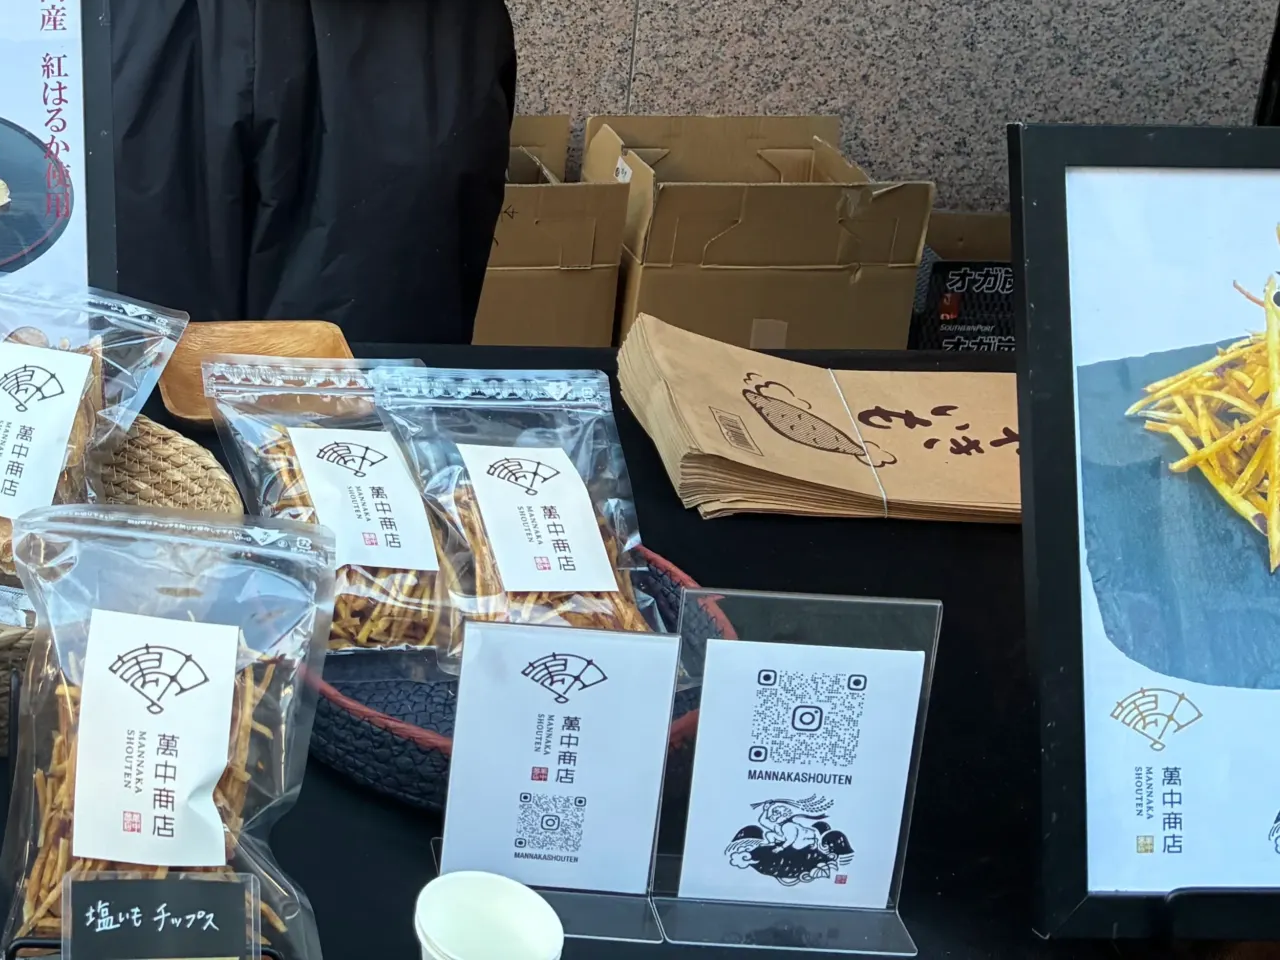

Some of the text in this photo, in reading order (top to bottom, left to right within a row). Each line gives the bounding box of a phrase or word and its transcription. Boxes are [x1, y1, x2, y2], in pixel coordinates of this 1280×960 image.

[41, 52, 71, 219] 紅はるか使用
[0, 425, 35, 497] 萬中商店
[347, 485, 363, 519] SHOUTEN
[355, 485, 372, 522] MANNAKA
[369, 486, 401, 548] 萬中商店
[517, 505, 534, 543] SHOUTEN
[526, 505, 543, 545] MANNAKA
[541, 505, 576, 571] 萬中商店
[123, 729, 136, 789] SHOUTEN
[534, 713, 545, 753] SHOUTEN
[543, 714, 555, 756] MANNAKA
[555, 715, 582, 784] 萬中商店
[134, 730, 147, 794] MANNAKA
[152, 733, 180, 838] 萬中商店
[747, 769, 853, 785] MANNAKASHOUTEN
[1134, 766, 1144, 817] SHOUTEN
[1145, 766, 1155, 820] MANNAKA
[1162, 766, 1183, 854] 萬中商店
[513, 851, 579, 863] MANNAKASHOUTEN
